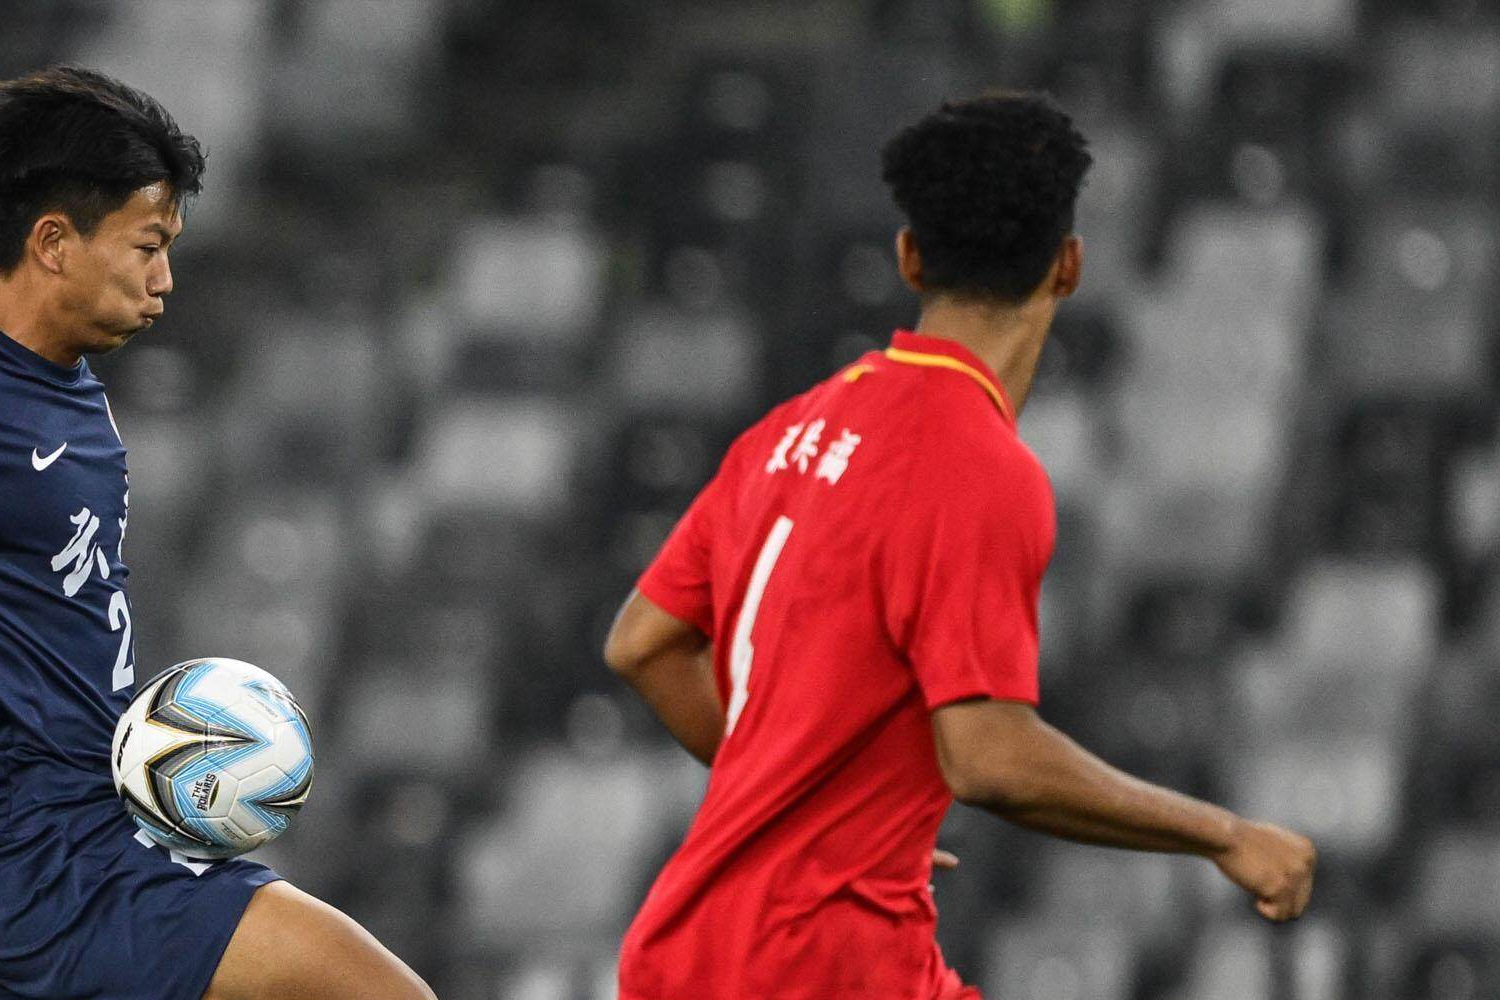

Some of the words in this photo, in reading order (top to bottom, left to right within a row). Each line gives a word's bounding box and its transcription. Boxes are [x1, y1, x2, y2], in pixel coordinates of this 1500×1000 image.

[51, 475, 129, 597] 云
[108, 590, 135, 692] 2
[192, 781, 203, 798] THE
[197, 773, 217, 811] POLARIS
